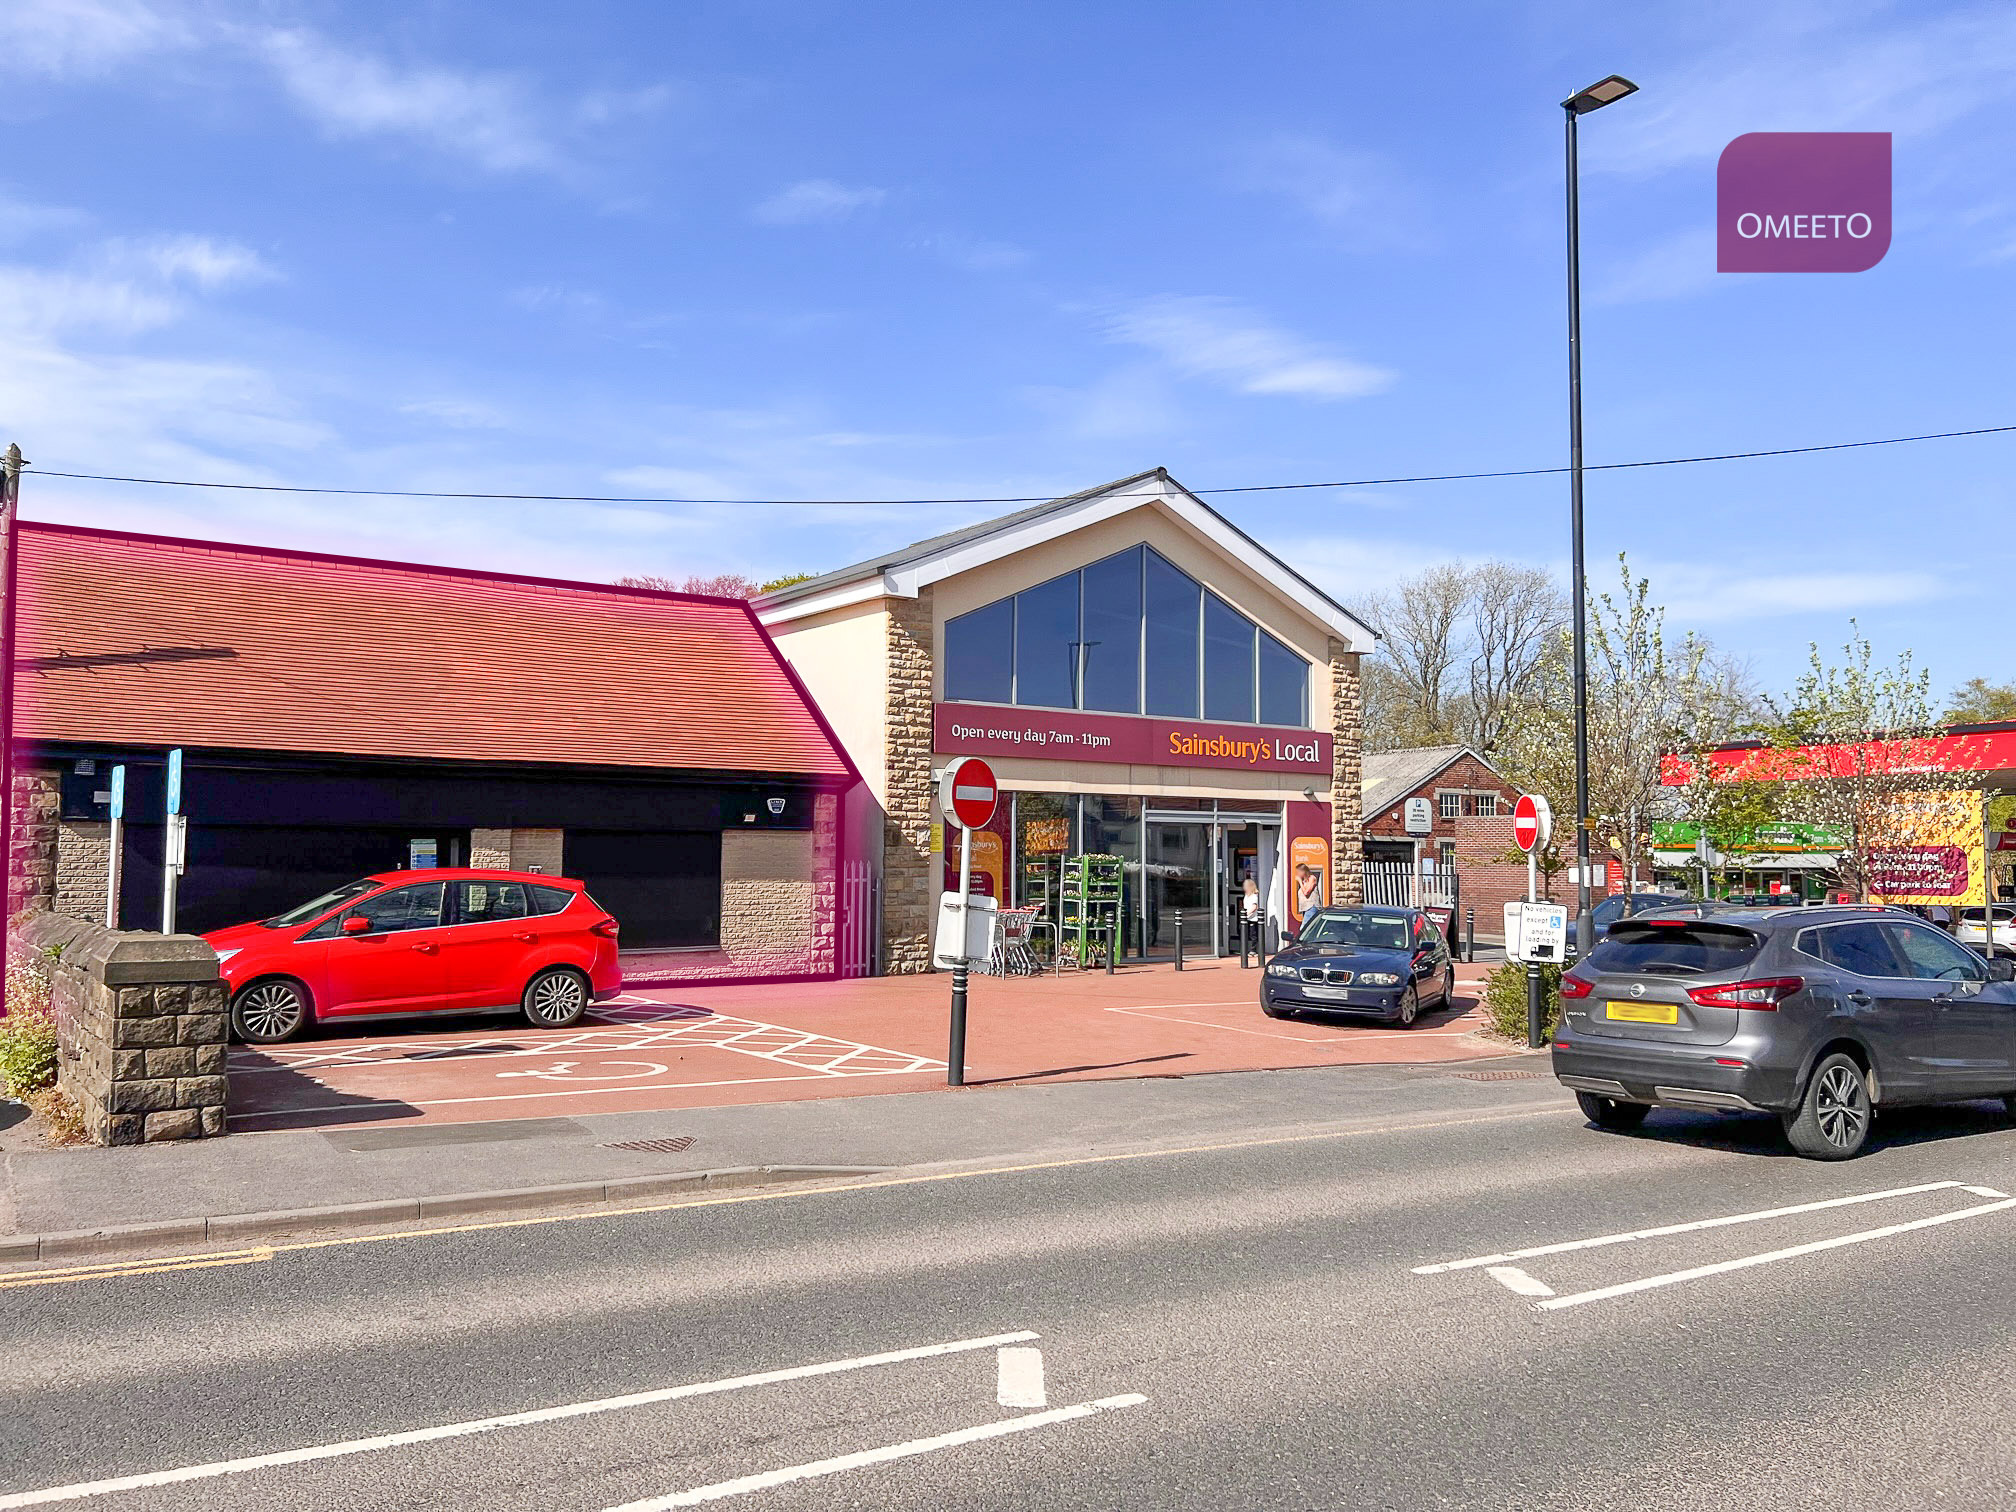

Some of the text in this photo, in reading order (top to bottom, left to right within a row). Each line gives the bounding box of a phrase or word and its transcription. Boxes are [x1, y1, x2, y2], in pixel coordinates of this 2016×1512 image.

[951, 724, 985, 740] Open
[987, 729, 1021, 743] every
[1023, 728, 1046, 745] day
[1048, 730, 1074, 744] 7am
[1081, 733, 1111, 748] 11pm
[1169, 731, 1320, 764] Sainsbury's Local
[1293, 841, 1325, 850] Sainsbury's
[1526, 936, 1550, 944] loading
